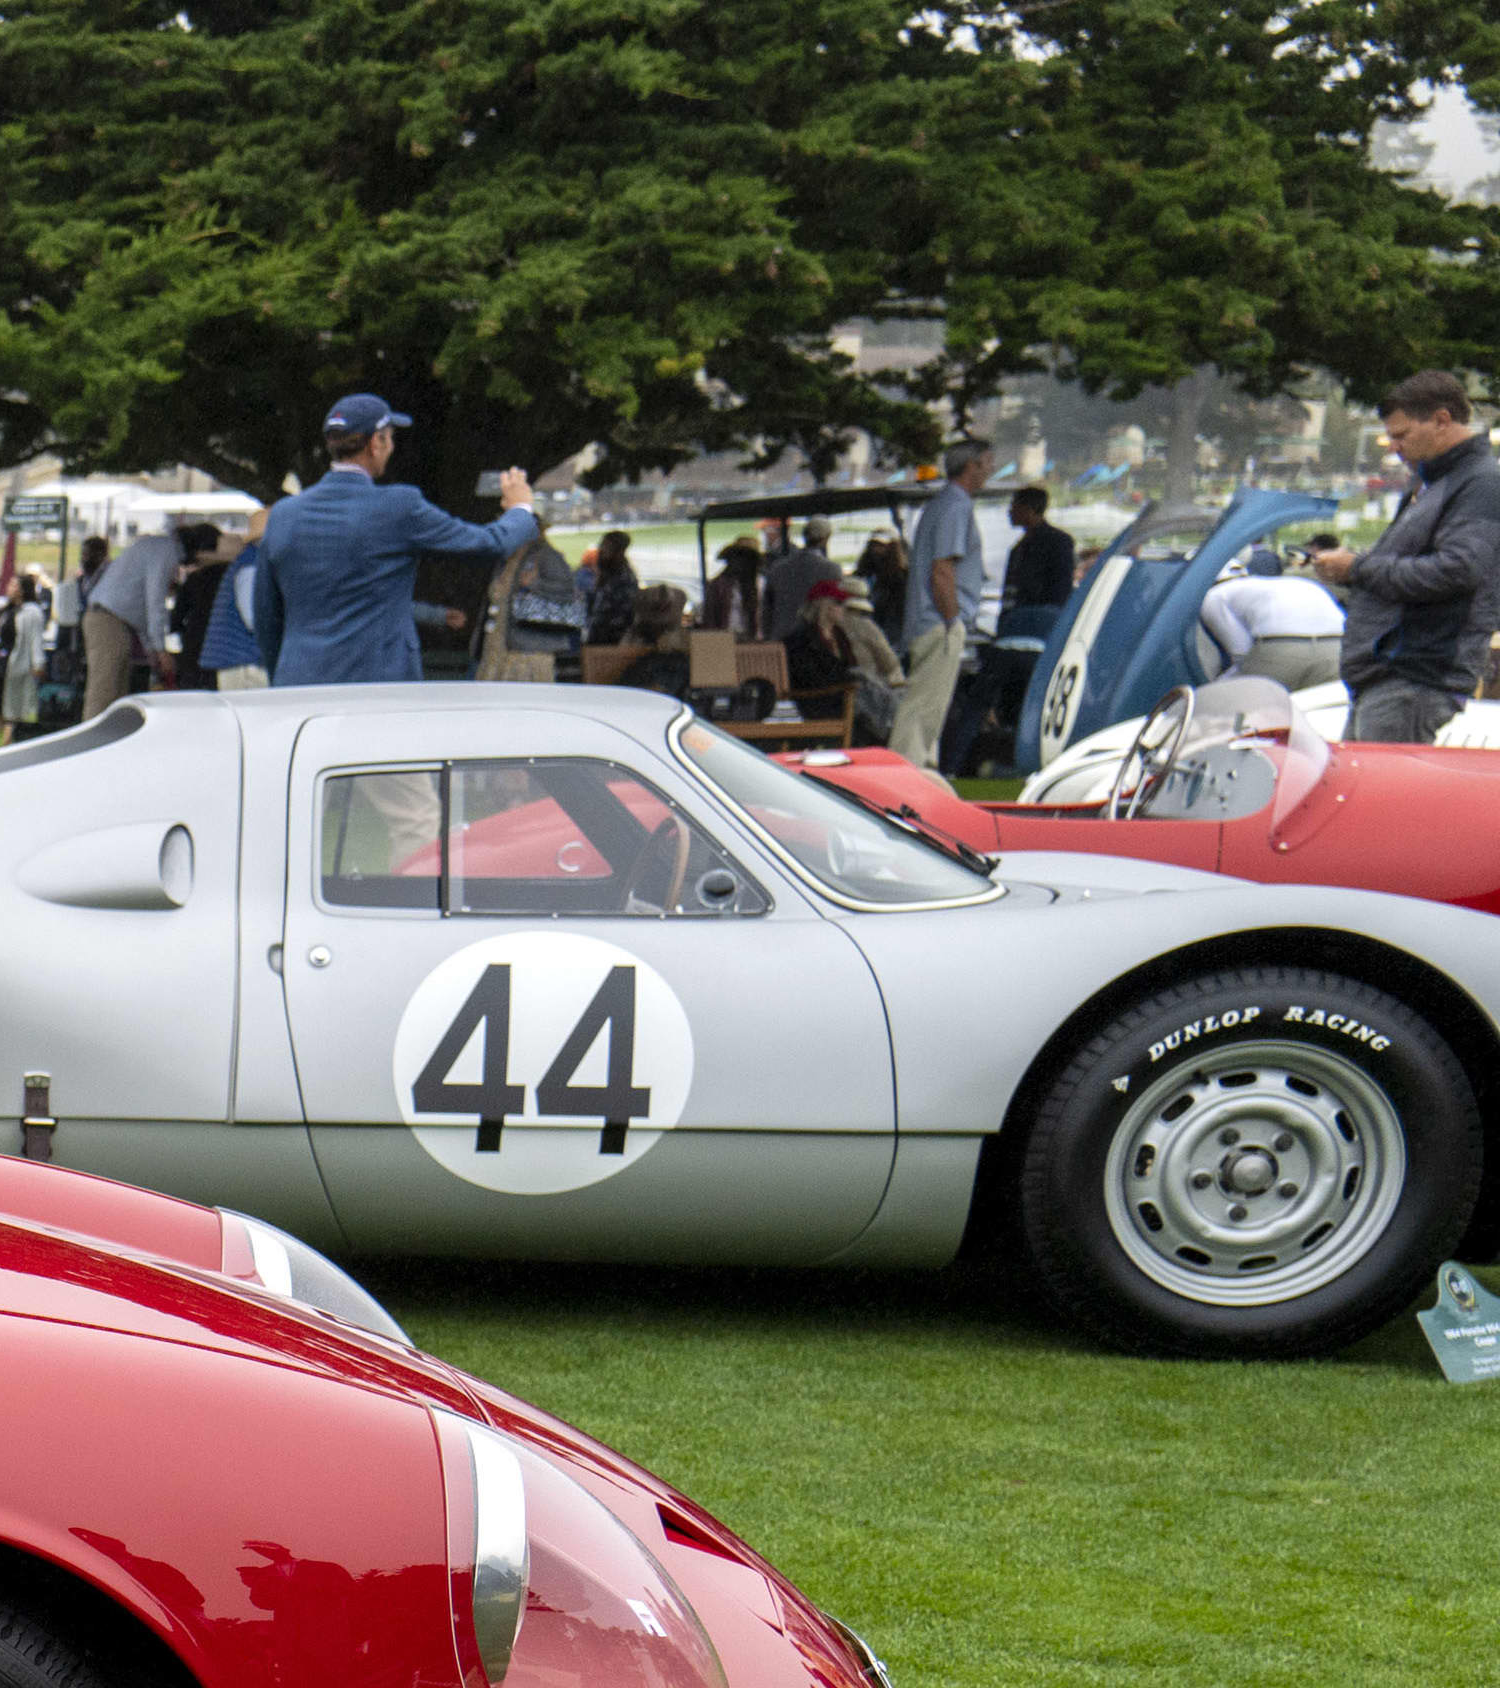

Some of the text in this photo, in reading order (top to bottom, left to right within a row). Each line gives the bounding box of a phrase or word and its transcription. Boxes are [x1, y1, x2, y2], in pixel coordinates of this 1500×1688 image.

[412, 962, 652, 1155] 44
[1148, 1005, 1392, 1062] DUNLOP RACING
